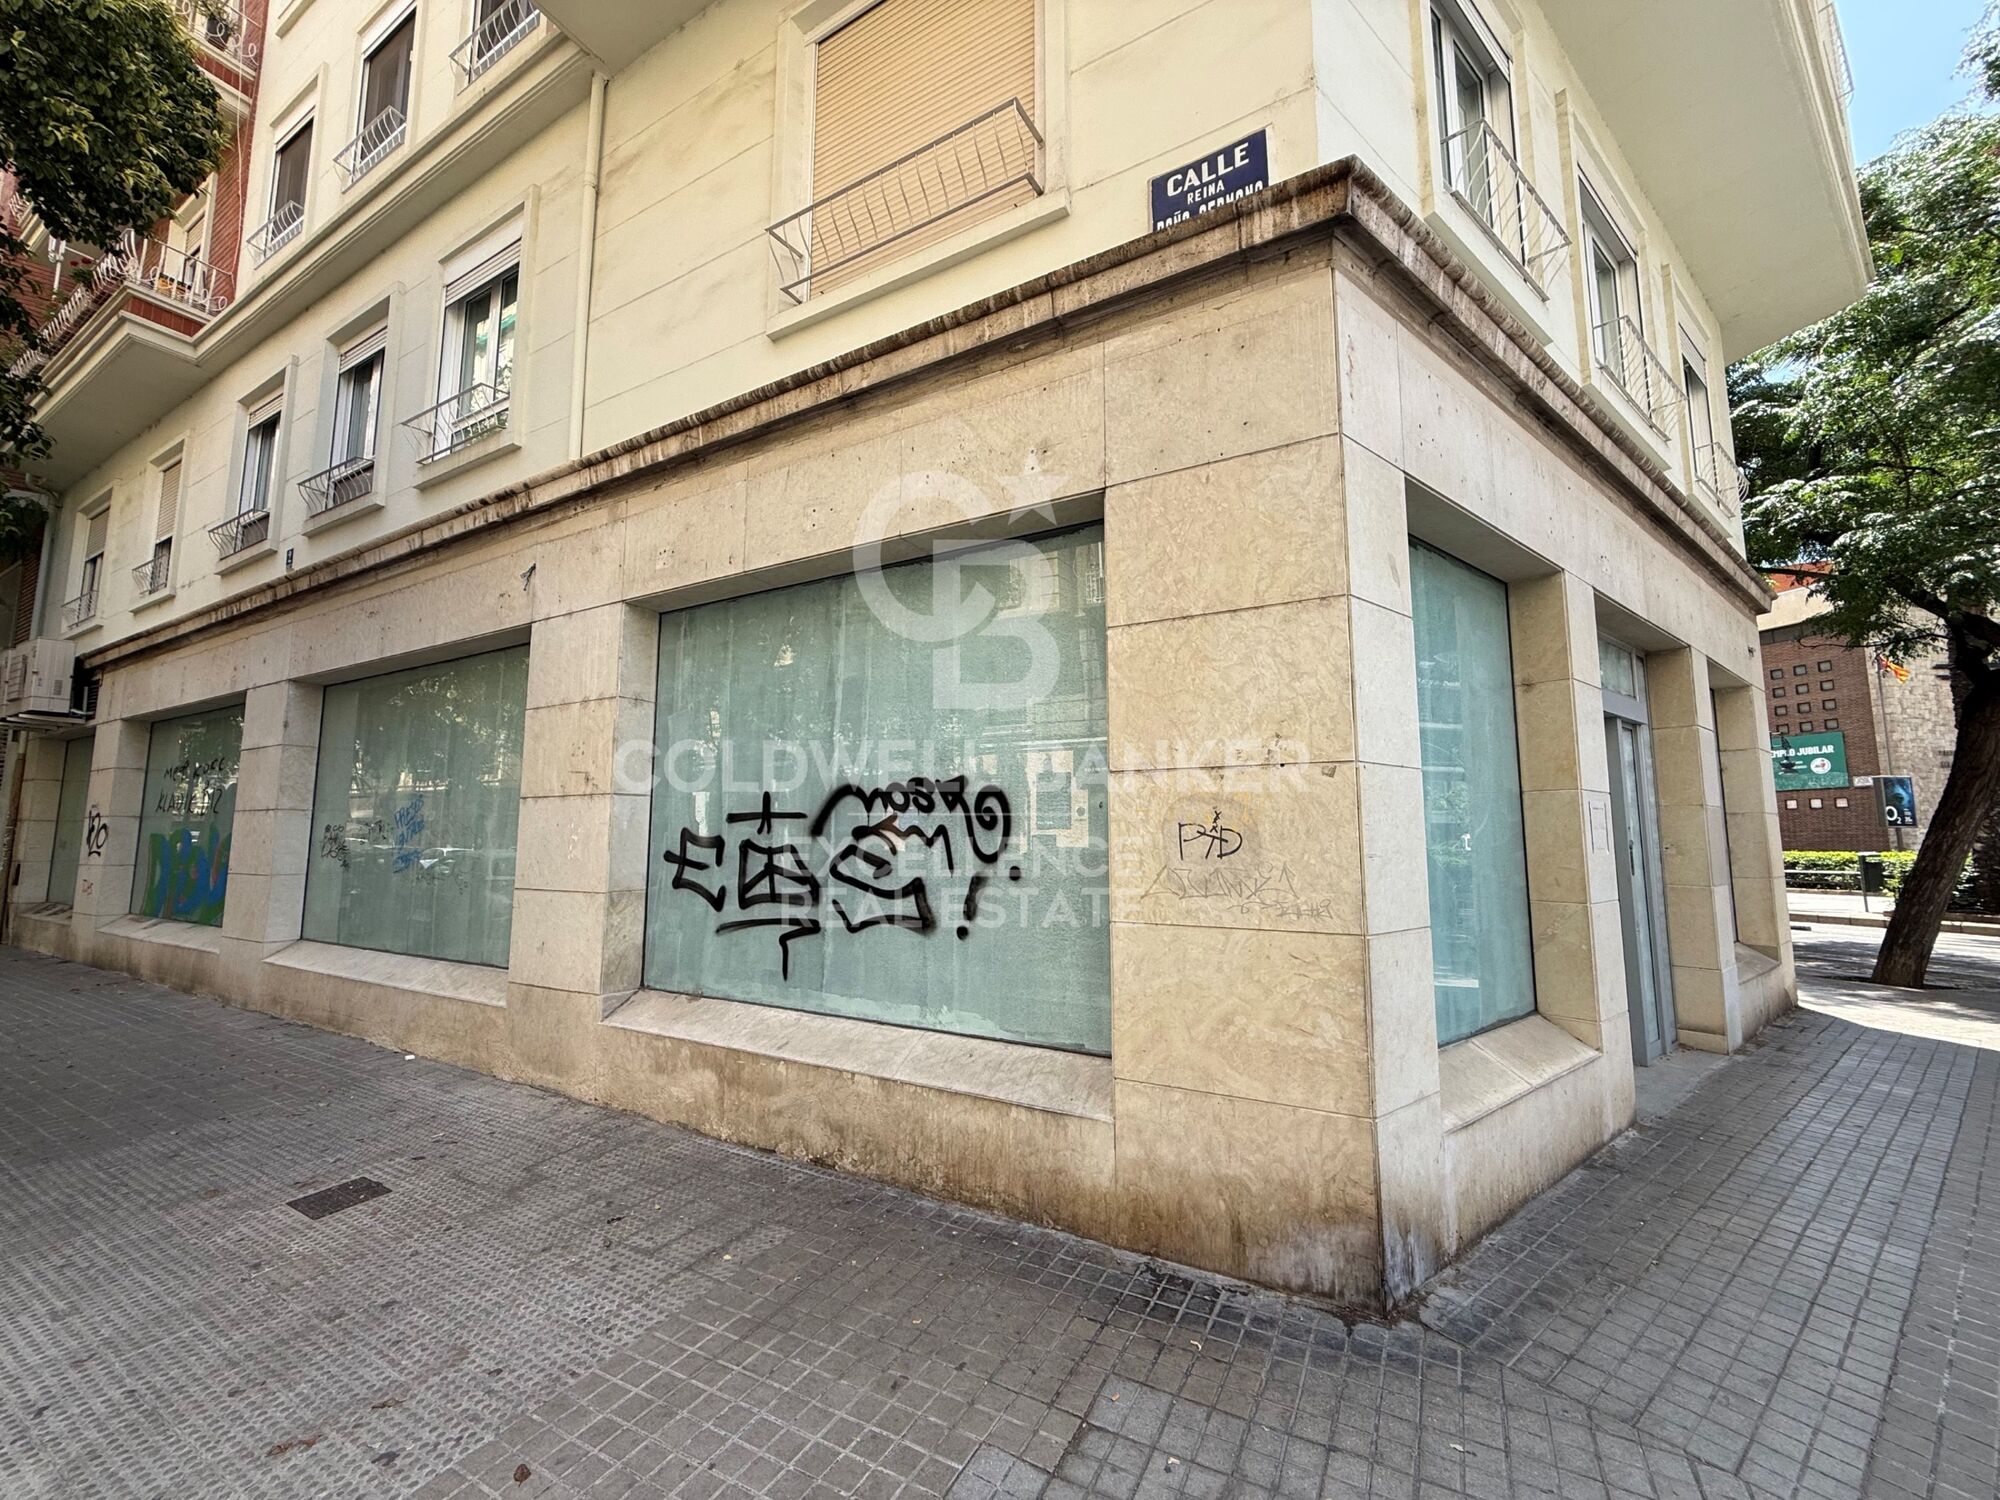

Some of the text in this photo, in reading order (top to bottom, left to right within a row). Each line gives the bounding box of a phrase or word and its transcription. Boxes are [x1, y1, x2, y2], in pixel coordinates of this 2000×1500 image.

[1167, 142, 1249, 197] CALLE
[1187, 179, 1225, 205] REINA
[1796, 744, 1835, 757] JUBILAR
